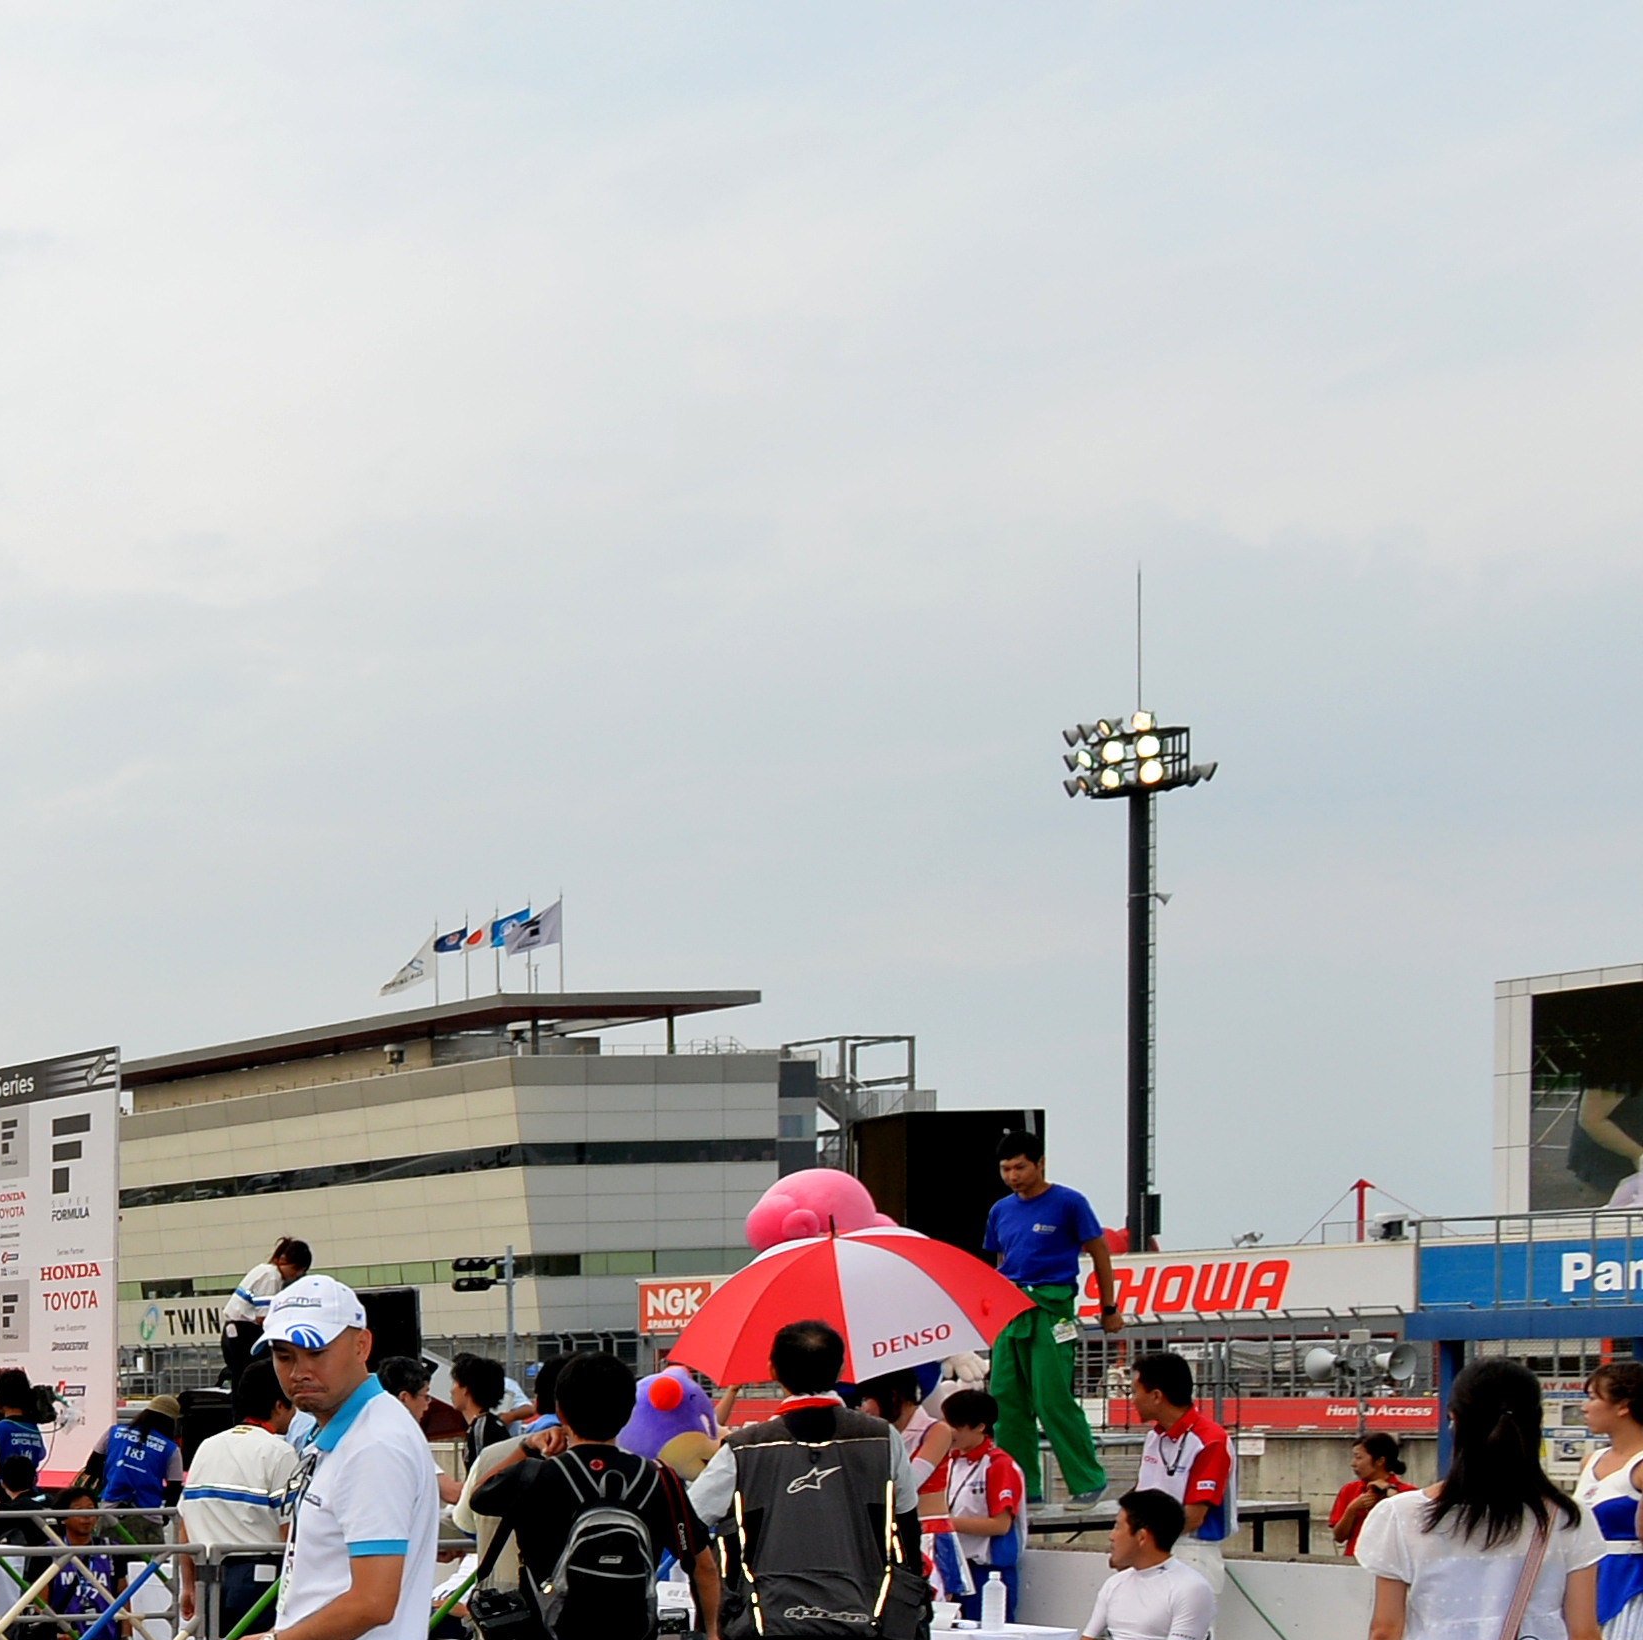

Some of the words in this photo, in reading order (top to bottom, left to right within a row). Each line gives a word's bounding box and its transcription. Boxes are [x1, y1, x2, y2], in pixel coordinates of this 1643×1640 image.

[51, 1206, 90, 1222] FORMULA
[40, 1262, 101, 1281] HONDA
[43, 1290, 98, 1311] TOYOTA
[647, 1286, 703, 1317] NGK
[872, 1322, 952, 1359] DENSO
[1377, 1404, 1433, 1417] Access
[124, 1446, 146, 1461] 183
